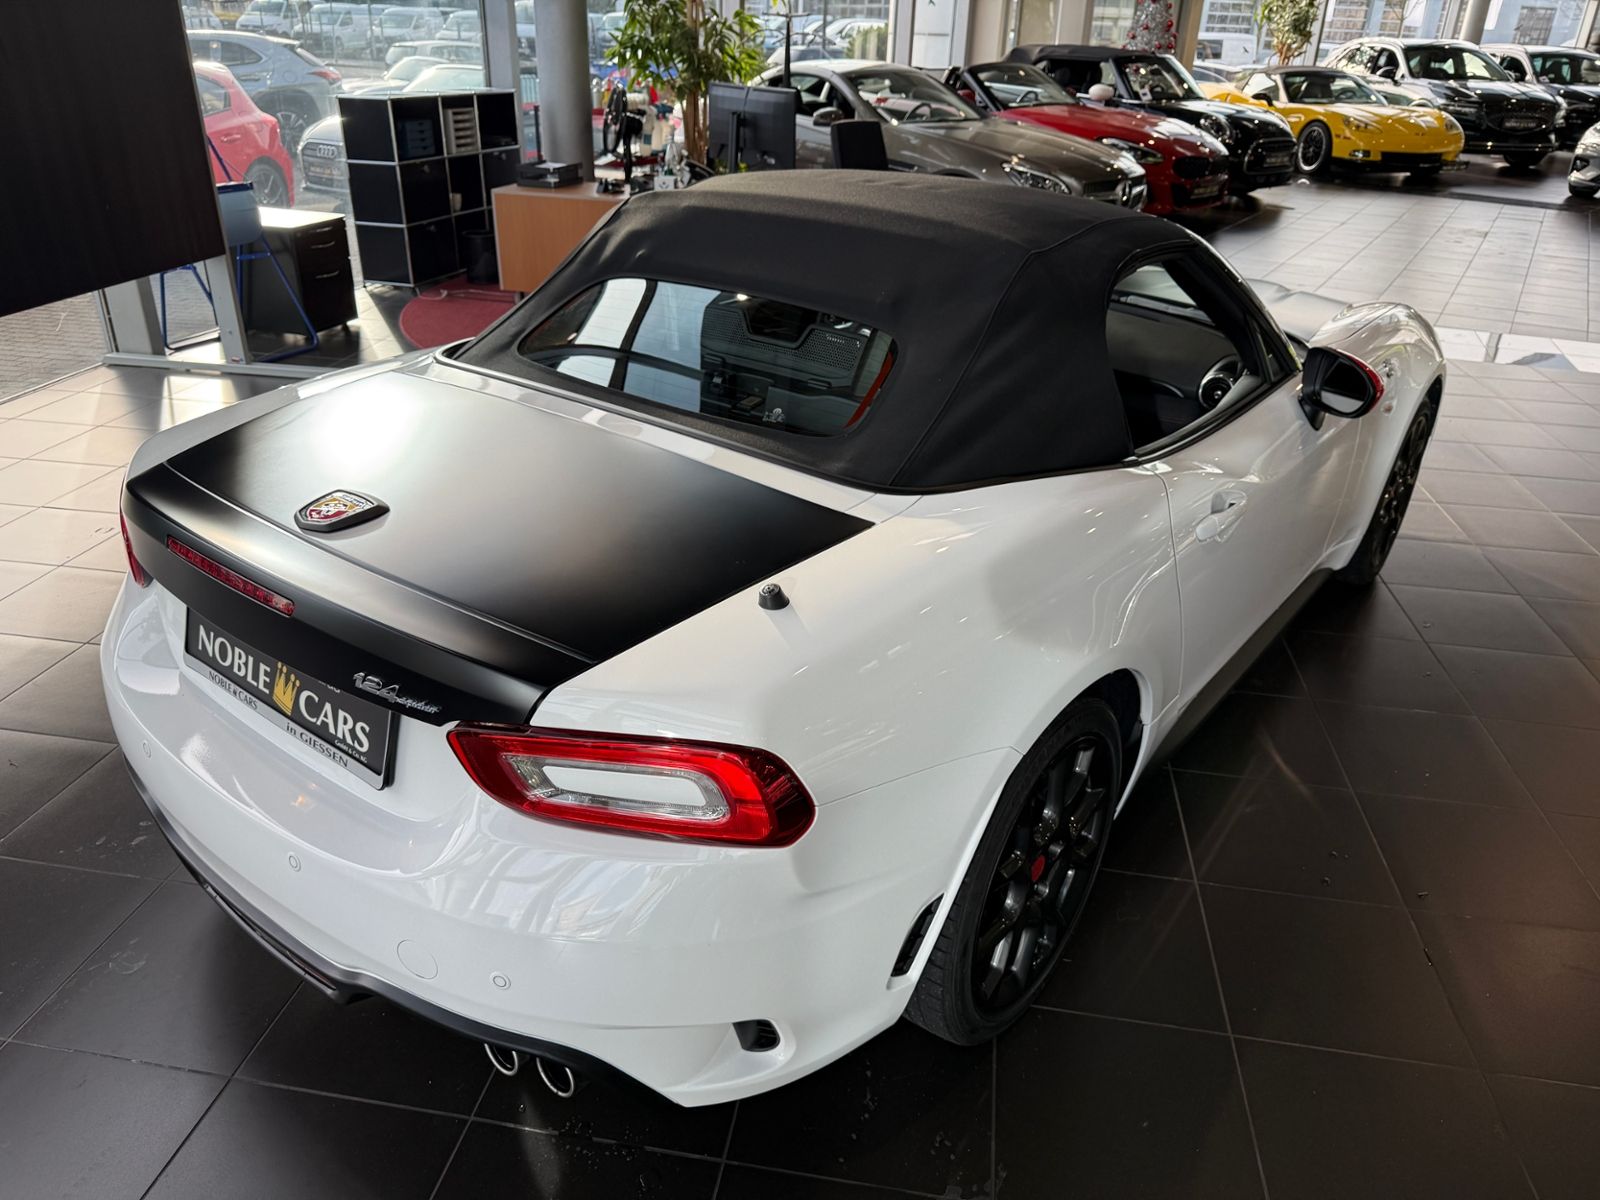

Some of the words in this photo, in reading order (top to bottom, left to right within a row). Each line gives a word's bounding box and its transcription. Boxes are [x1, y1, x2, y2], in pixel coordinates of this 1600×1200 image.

[198, 624, 271, 694] NOBLE
[299, 690, 370, 753] CARS
[208, 670, 232, 693] NOBLE
[238, 690, 258, 711] CARS
[353, 672, 399, 703] 124
[286, 722, 297, 736] in
[300, 731, 348, 767] GIESSEN
